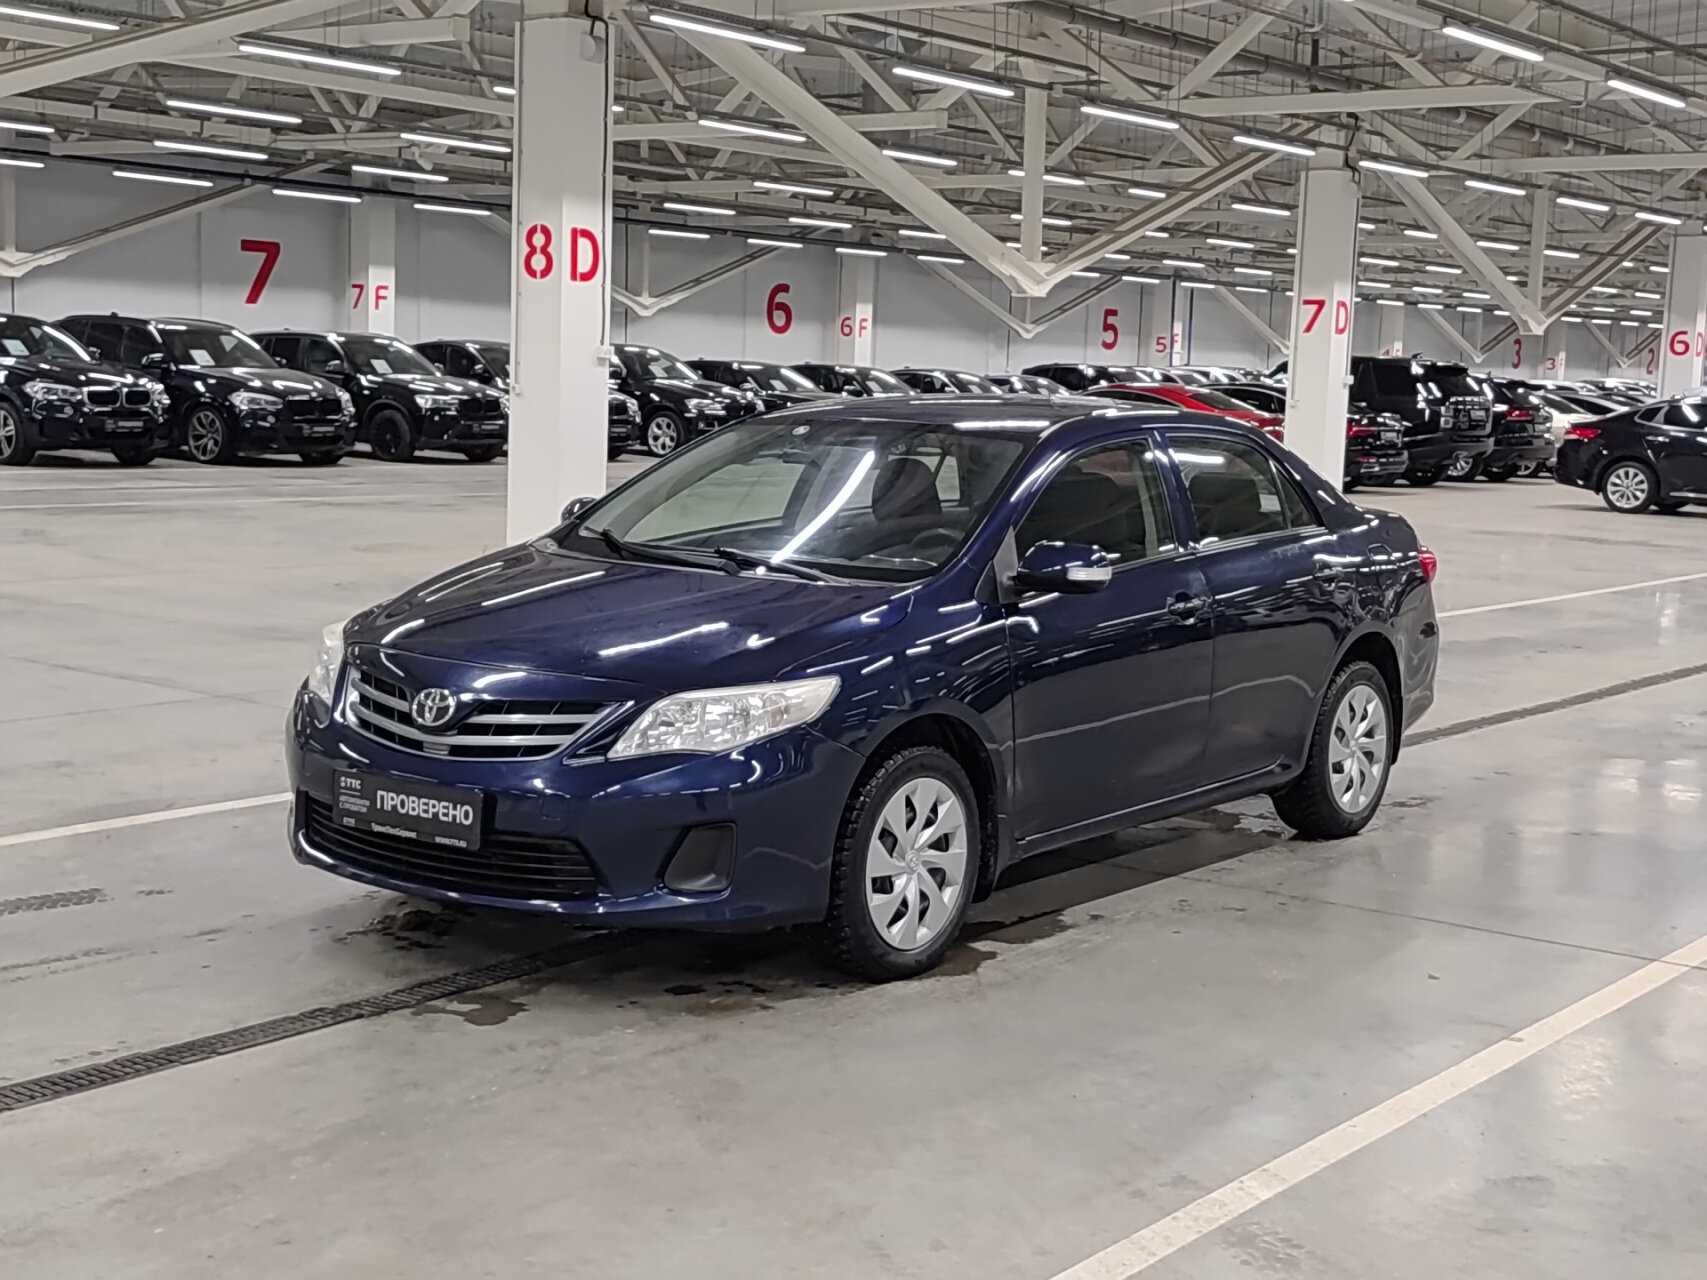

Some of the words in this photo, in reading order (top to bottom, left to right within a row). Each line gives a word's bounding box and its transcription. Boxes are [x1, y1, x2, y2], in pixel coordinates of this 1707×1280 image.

[524, 223, 553, 279] 8
[570, 227, 600, 282] D
[240, 238, 281, 304] 7
[351, 284, 364, 310] 7
[374, 285, 389, 310] F
[766, 282, 793, 335] 6
[840, 316, 853, 337] 6
[859, 318, 868, 338] F
[1101, 308, 1119, 350] 5
[1302, 299, 1326, 333] 7
[1334, 300, 1349, 335] D
[1155, 336, 1167, 353] 5
[1511, 338, 1522, 369] 3
[1669, 330, 1690, 356] 6
[1695, 332, 1704, 357] D
[1545, 357, 1556, 370] 3
[1646, 347, 1655, 375] 2
[376, 790, 473, 825] ПРОВЕРЕНО
